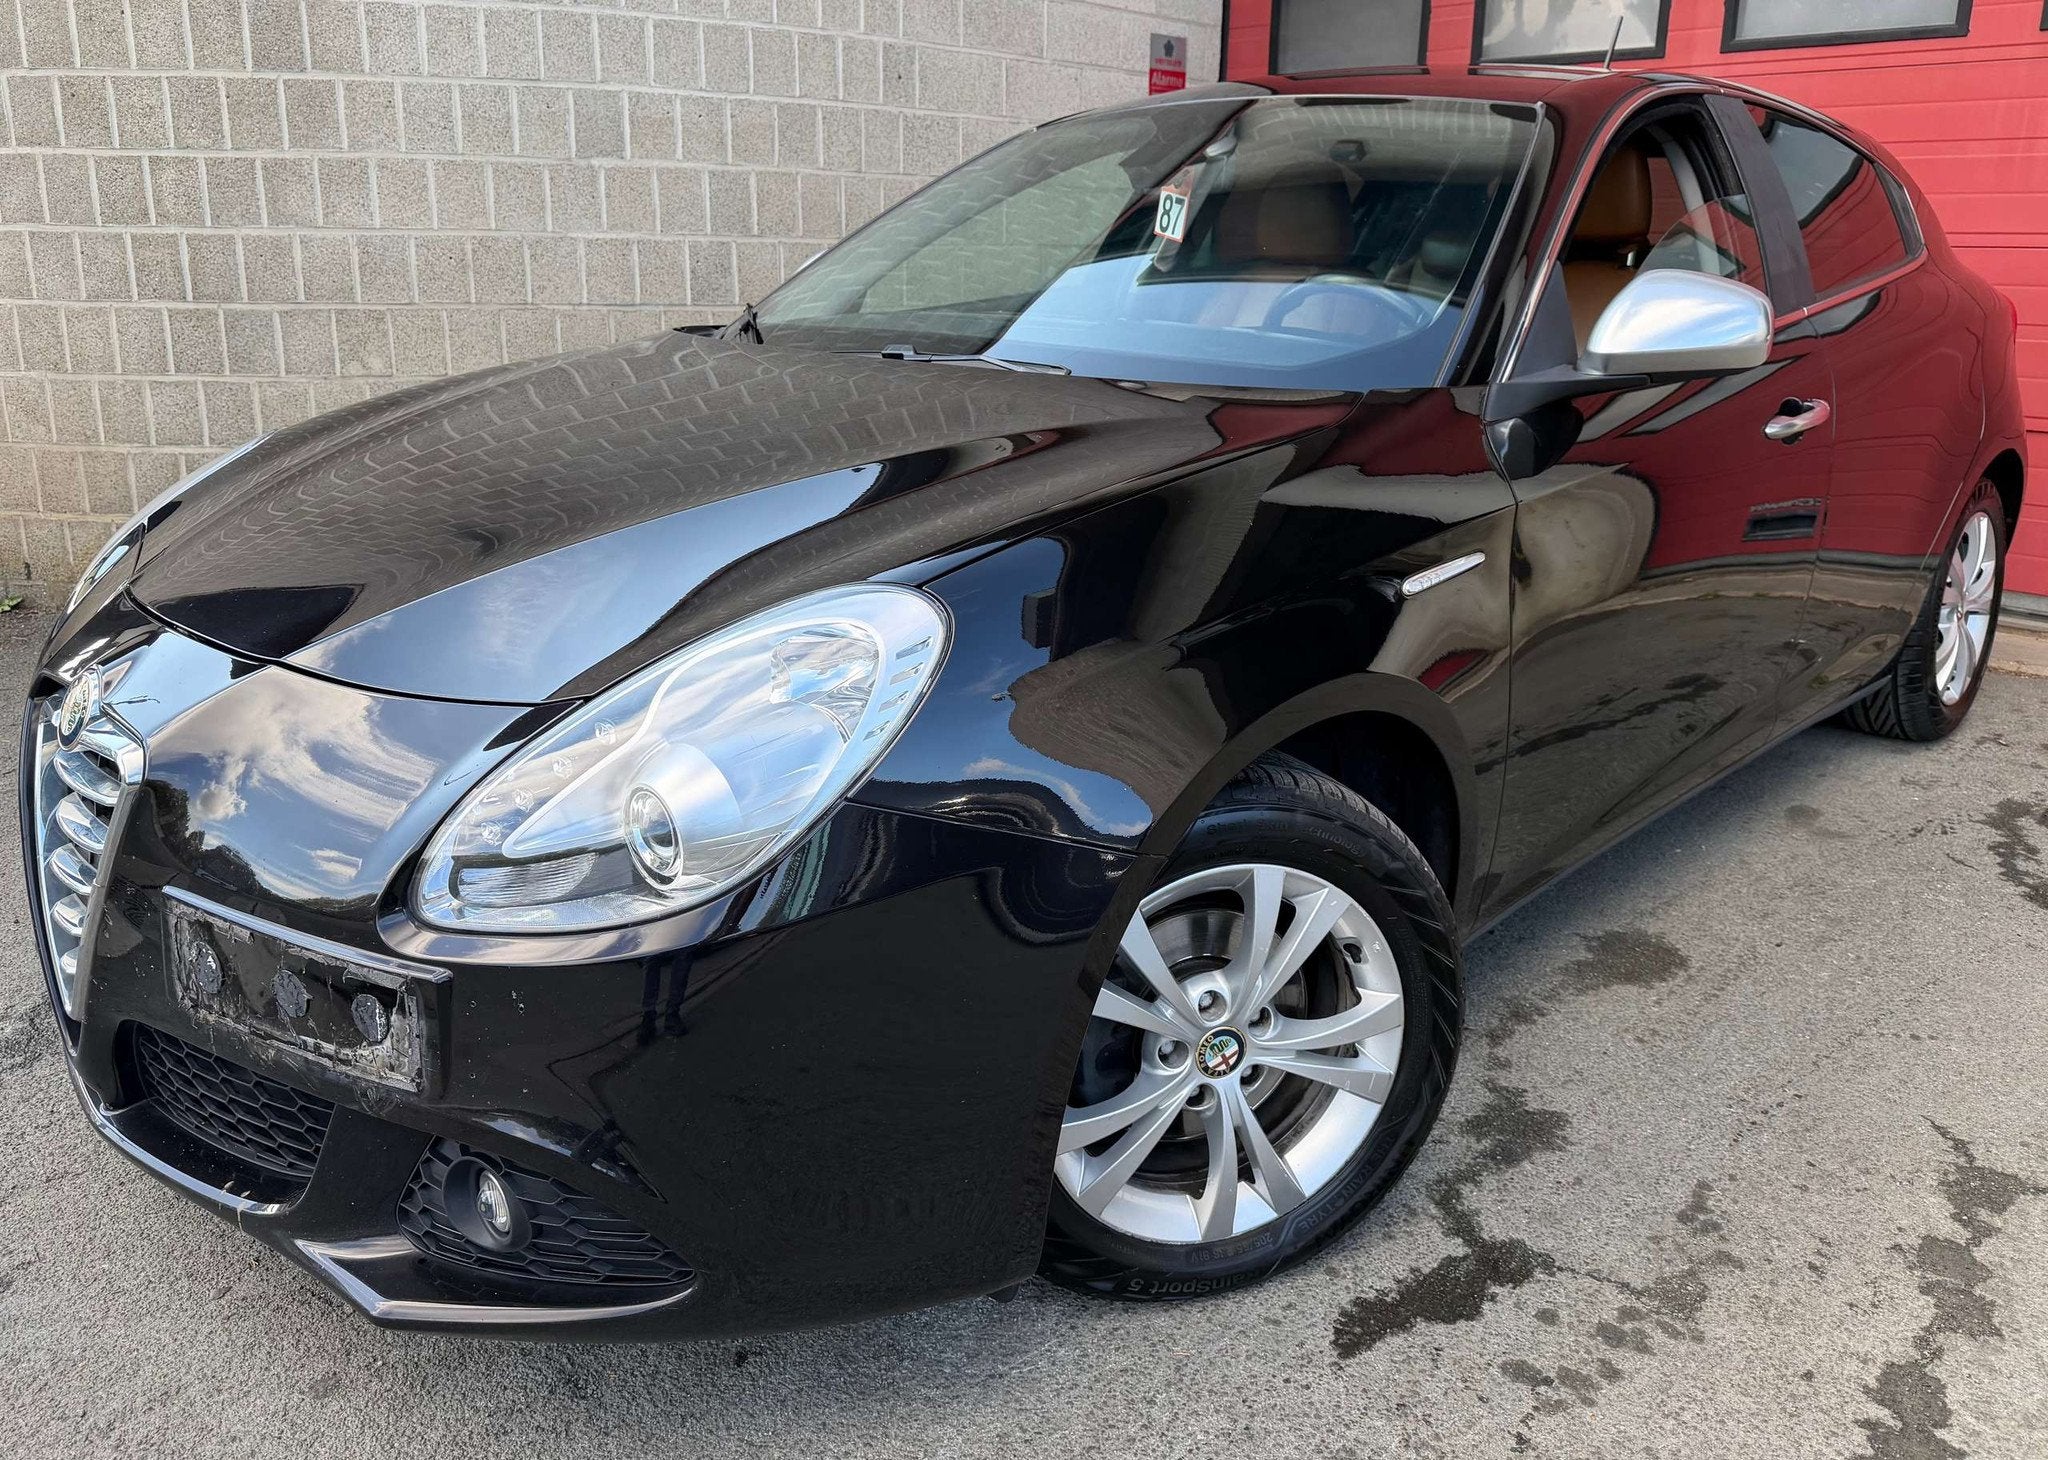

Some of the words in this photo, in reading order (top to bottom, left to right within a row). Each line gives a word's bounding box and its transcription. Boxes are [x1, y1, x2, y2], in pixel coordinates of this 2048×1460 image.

[1151, 71, 1184, 88] Alarme
[1160, 194, 1186, 235] 87
[1199, 1035, 1214, 1068] ROMEO
[1299, 1200, 1336, 1230] TYRE
[1127, 1277, 1145, 1292] 5
